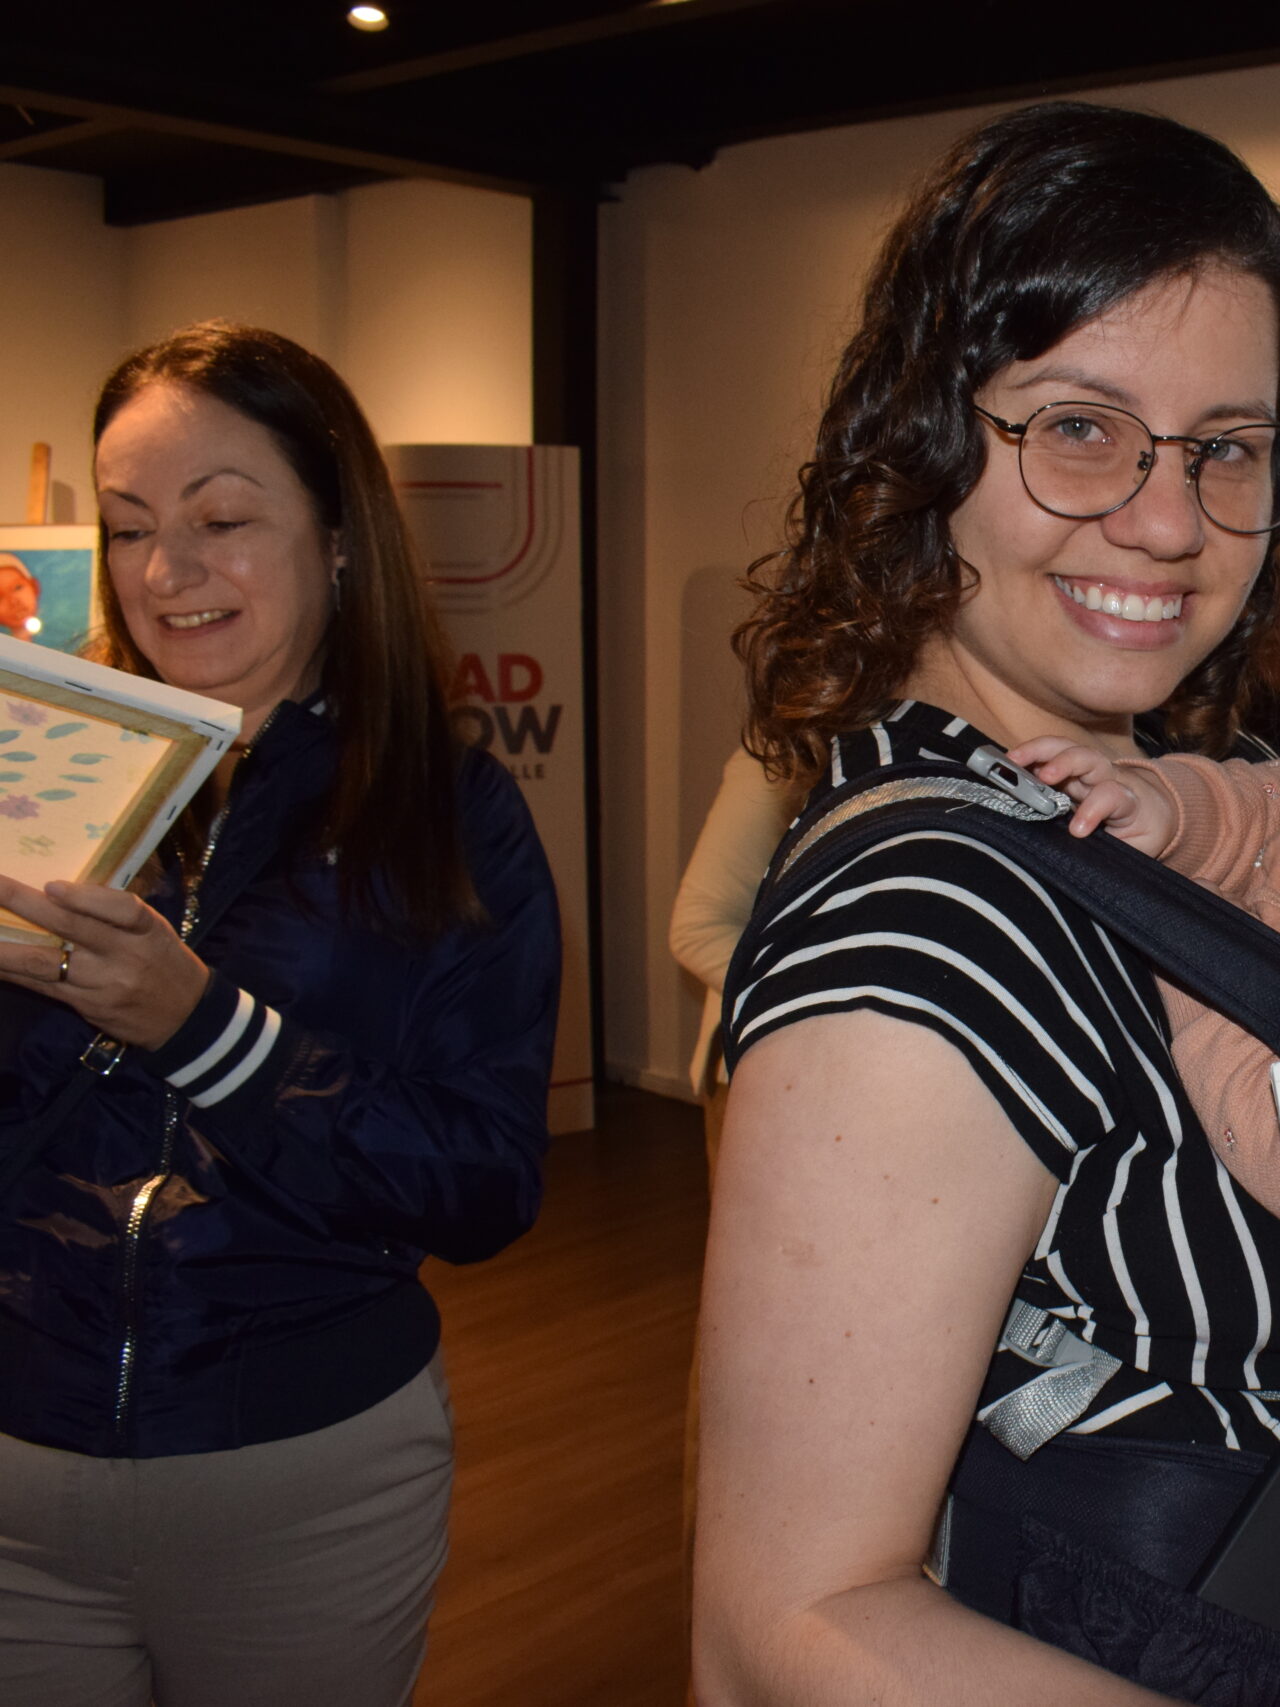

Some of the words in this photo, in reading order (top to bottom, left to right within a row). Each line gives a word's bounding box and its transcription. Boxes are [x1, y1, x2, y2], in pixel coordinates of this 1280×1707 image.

[449, 653, 544, 703] AD
[449, 704, 562, 755] OW
[510, 763, 545, 780] LLE
